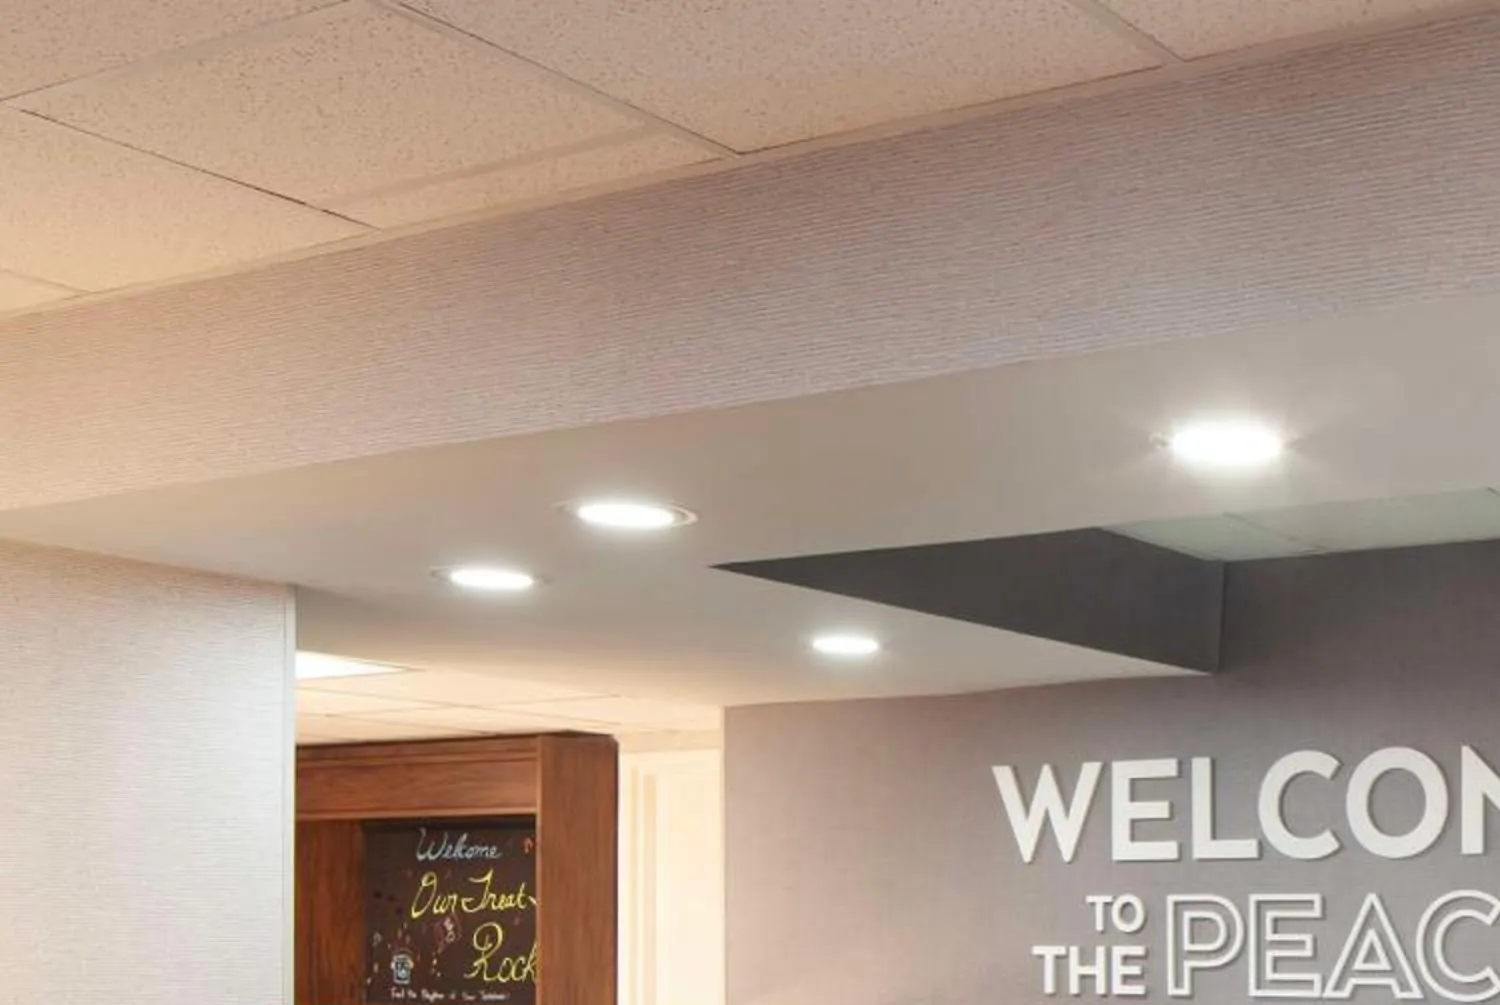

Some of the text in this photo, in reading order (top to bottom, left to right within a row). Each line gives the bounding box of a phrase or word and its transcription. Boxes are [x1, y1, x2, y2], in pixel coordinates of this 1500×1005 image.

[416, 827, 503, 861] Welcome
[411, 871, 458, 918] Our
[1087, 894, 1147, 932] TO
[1032, 944, 1148, 996] THE
